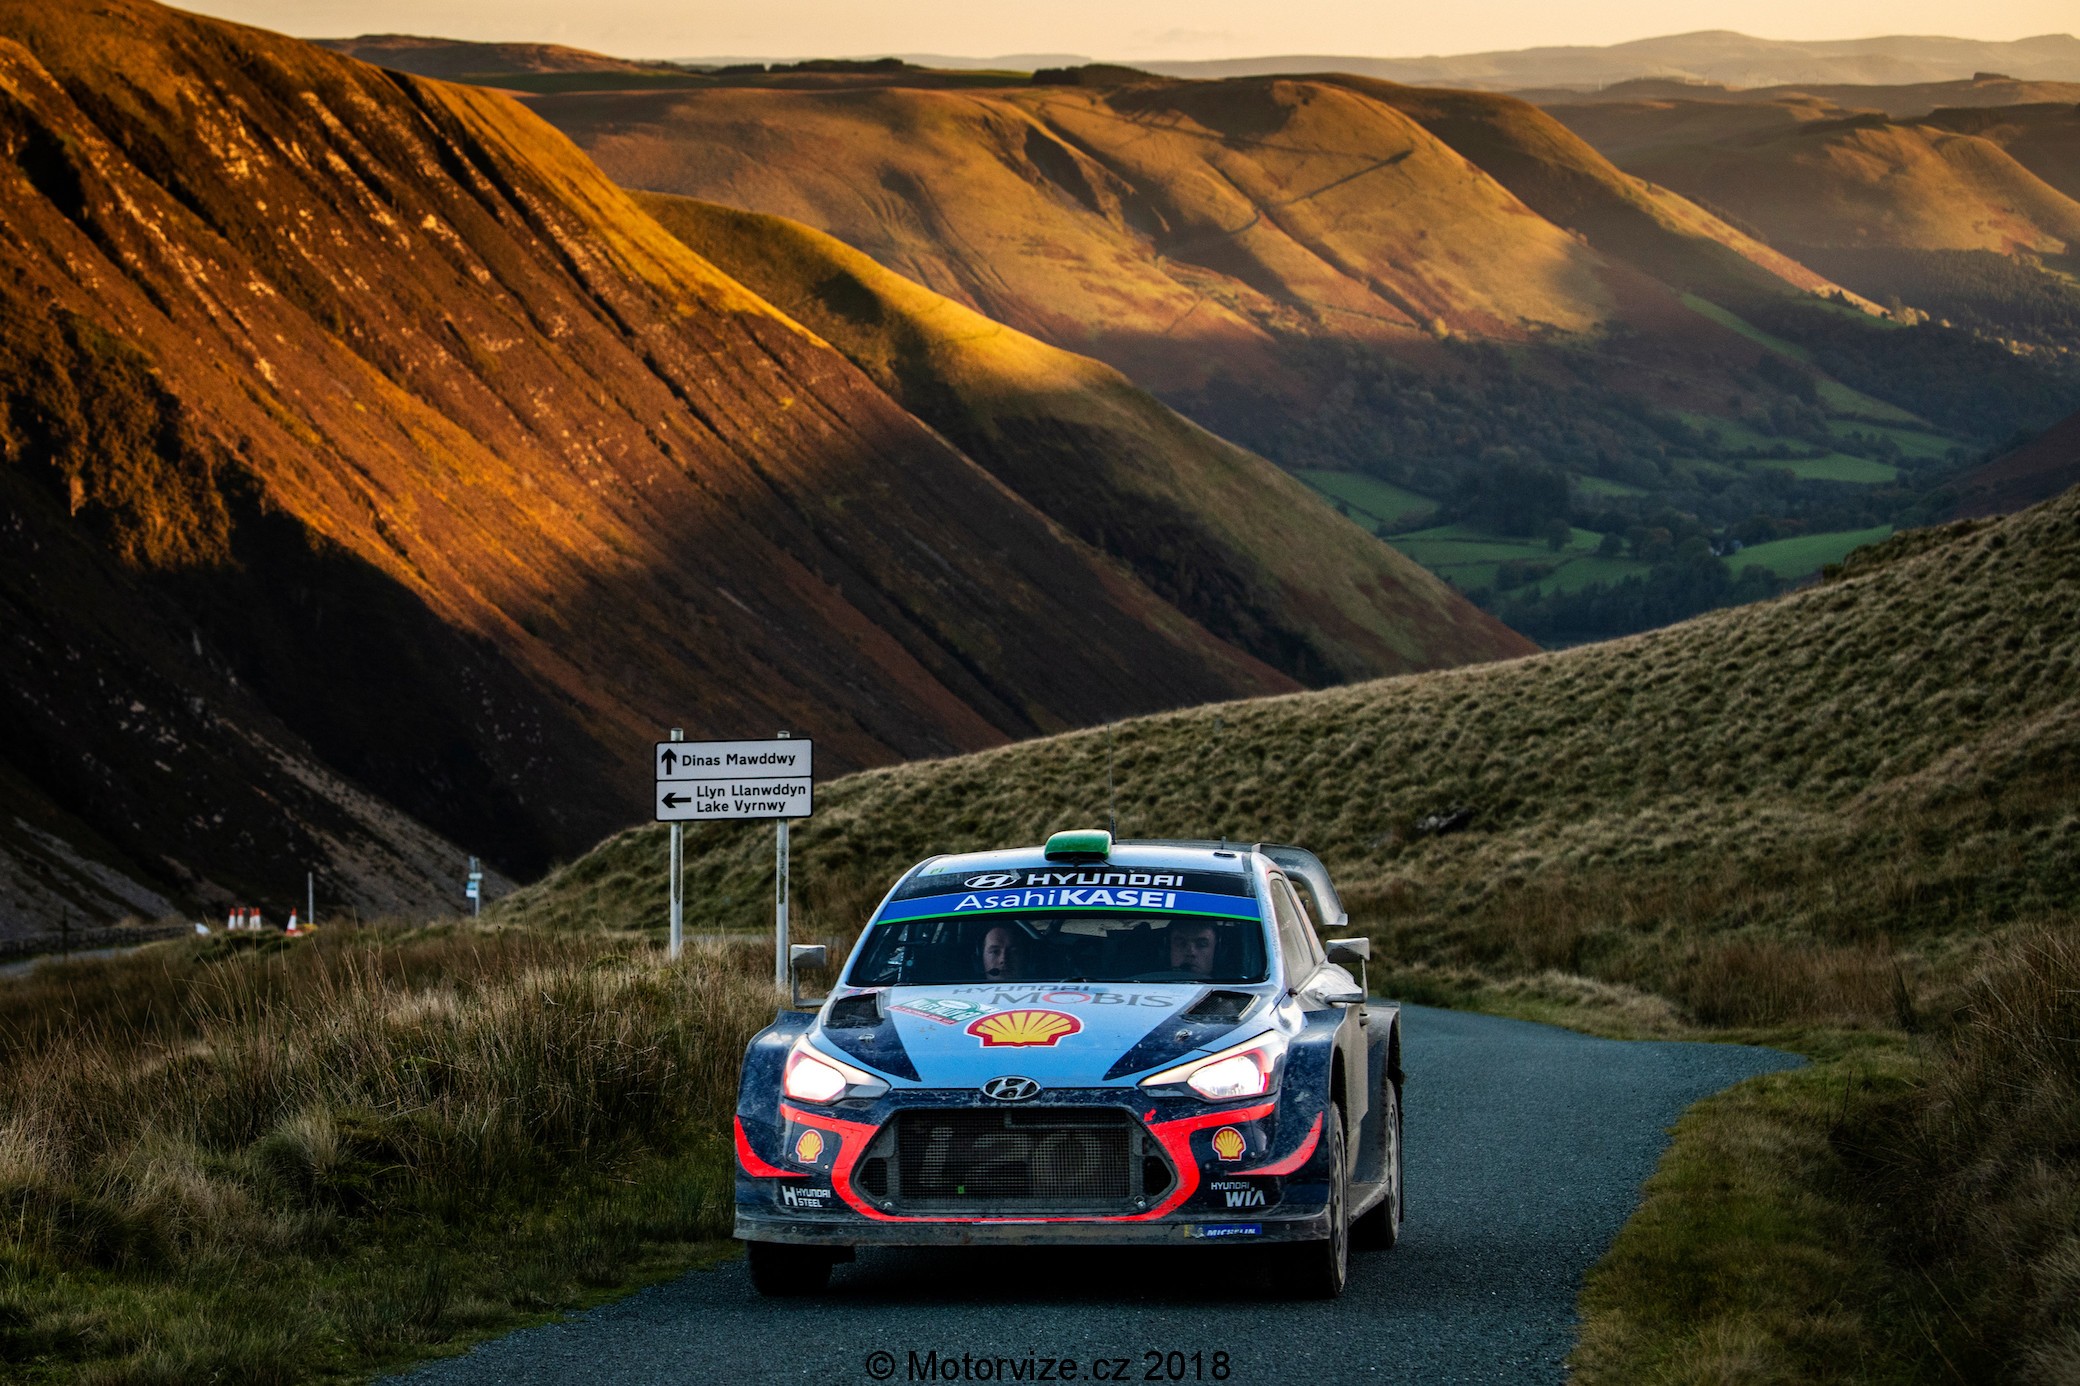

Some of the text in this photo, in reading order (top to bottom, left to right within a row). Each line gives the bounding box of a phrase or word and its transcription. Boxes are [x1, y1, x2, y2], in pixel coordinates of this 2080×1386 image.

[682, 753, 796, 766] Dinas Mawddwy
[697, 784, 806, 799] Llyn Llanwddyn
[697, 800, 786, 813] Lake Vyrnwy
[1027, 873, 1184, 887] HYUNDAI
[952, 985, 1090, 994] HYUNDAI
[990, 991, 1174, 1008] MOBIS
[1211, 1182, 1249, 1190] HYUNDAI
[796, 1188, 831, 1198] HYUNDAI
[798, 1198, 823, 1207] STEEL
